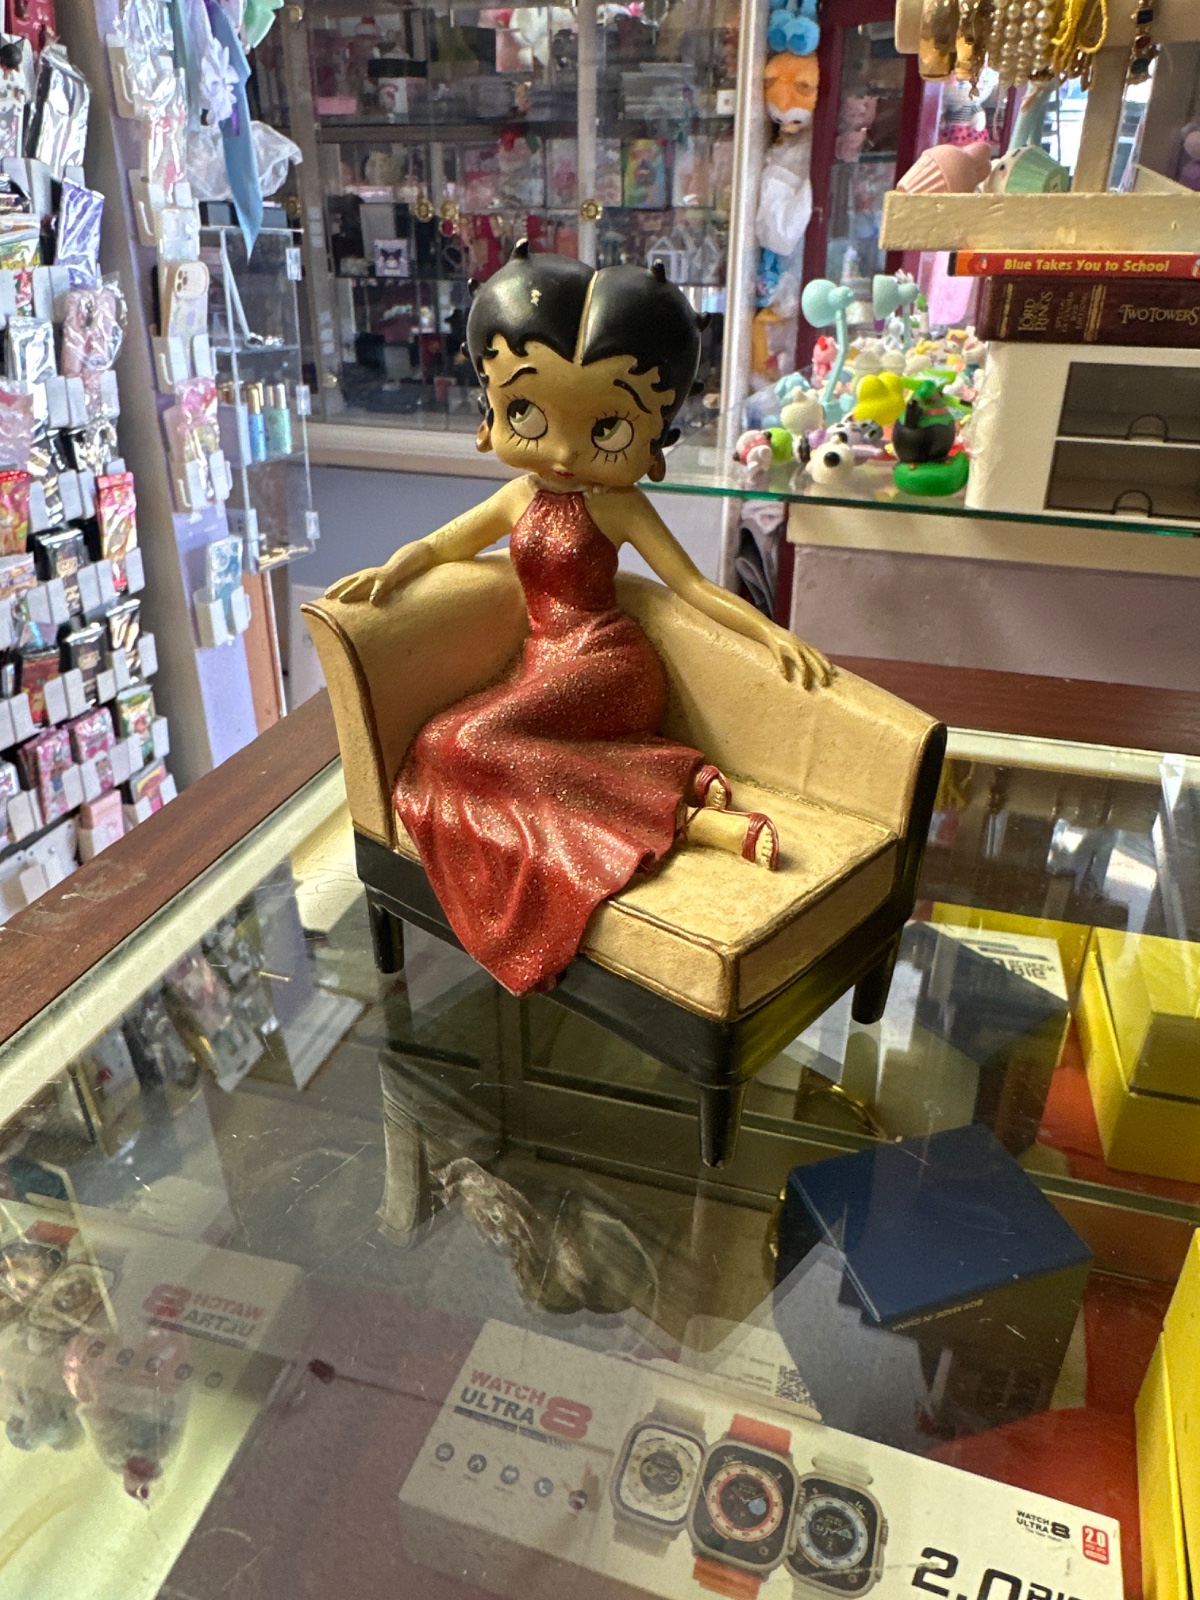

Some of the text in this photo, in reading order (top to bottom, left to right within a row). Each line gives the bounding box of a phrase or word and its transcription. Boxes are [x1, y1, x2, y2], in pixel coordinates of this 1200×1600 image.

[1004, 257, 1170, 273] Blue Takes You to School
[1018, 298, 1035, 331] LORD
[1033, 291, 1054, 331] RINGS
[470, 1370, 547, 1405] WATCH
[460, 1386, 535, 1425] ULTRA
[539, 1396, 593, 1440] 8
[1016, 1510, 1050, 1526] WATCH
[1016, 1517, 1049, 1534] ULTRA
[1051, 1521, 1071, 1540] 8
[1084, 1527, 1106, 1548] 2.0
[912, 1548, 1022, 1600] 2.0
